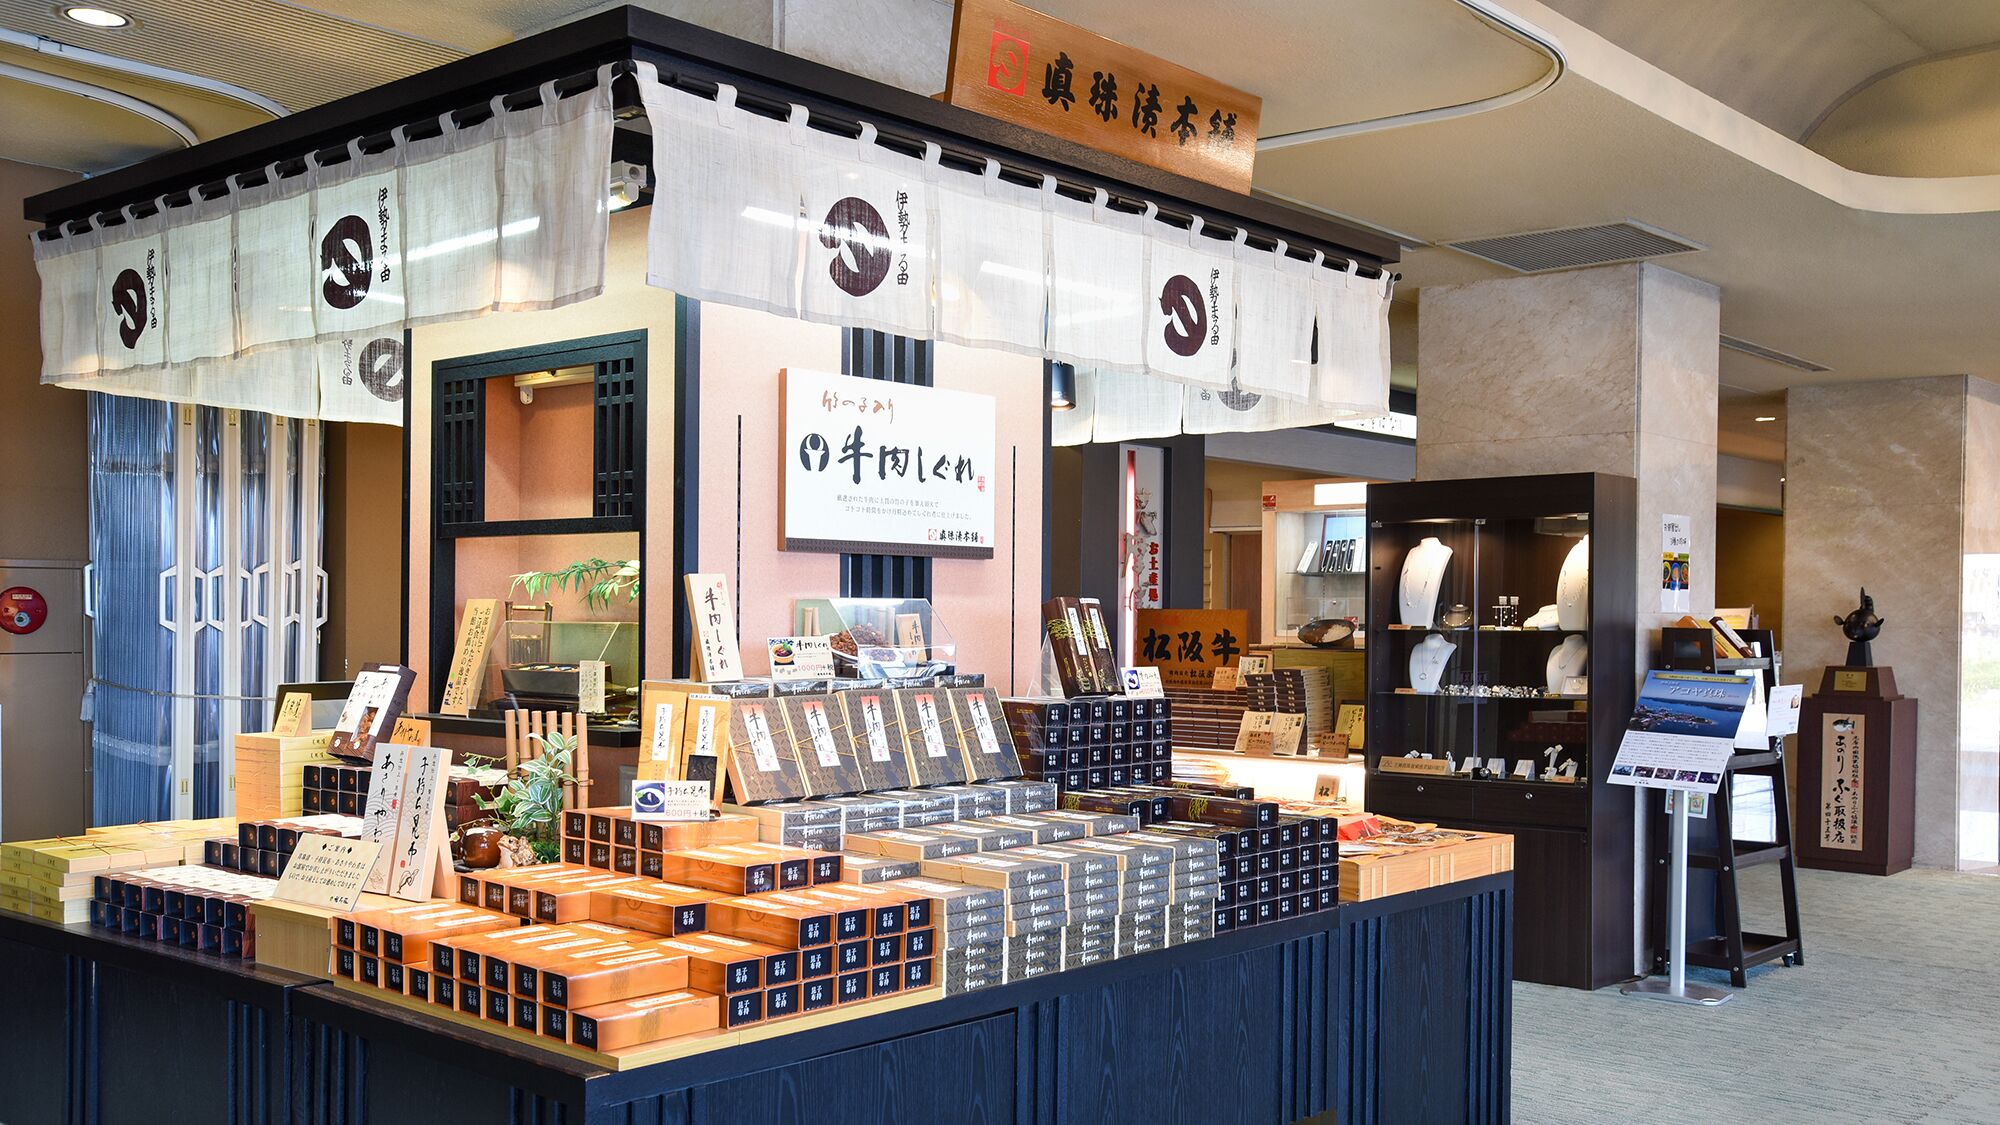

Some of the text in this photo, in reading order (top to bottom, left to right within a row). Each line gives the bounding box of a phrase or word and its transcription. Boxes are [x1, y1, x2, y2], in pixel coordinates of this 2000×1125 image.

[1208, 267, 1221, 346] 伊勢まる由
[837, 425, 974, 485] 牛肉しぐれ
[704, 587, 729, 670] 牛肉しぐれ
[1142, 628, 1241, 666] 松阪牛
[1669, 686, 1726, 699] アコヤ真珠
[408, 757, 429, 866] 子持ち昆布
[1832, 735, 1850, 844] あのりふぐ取扱店
